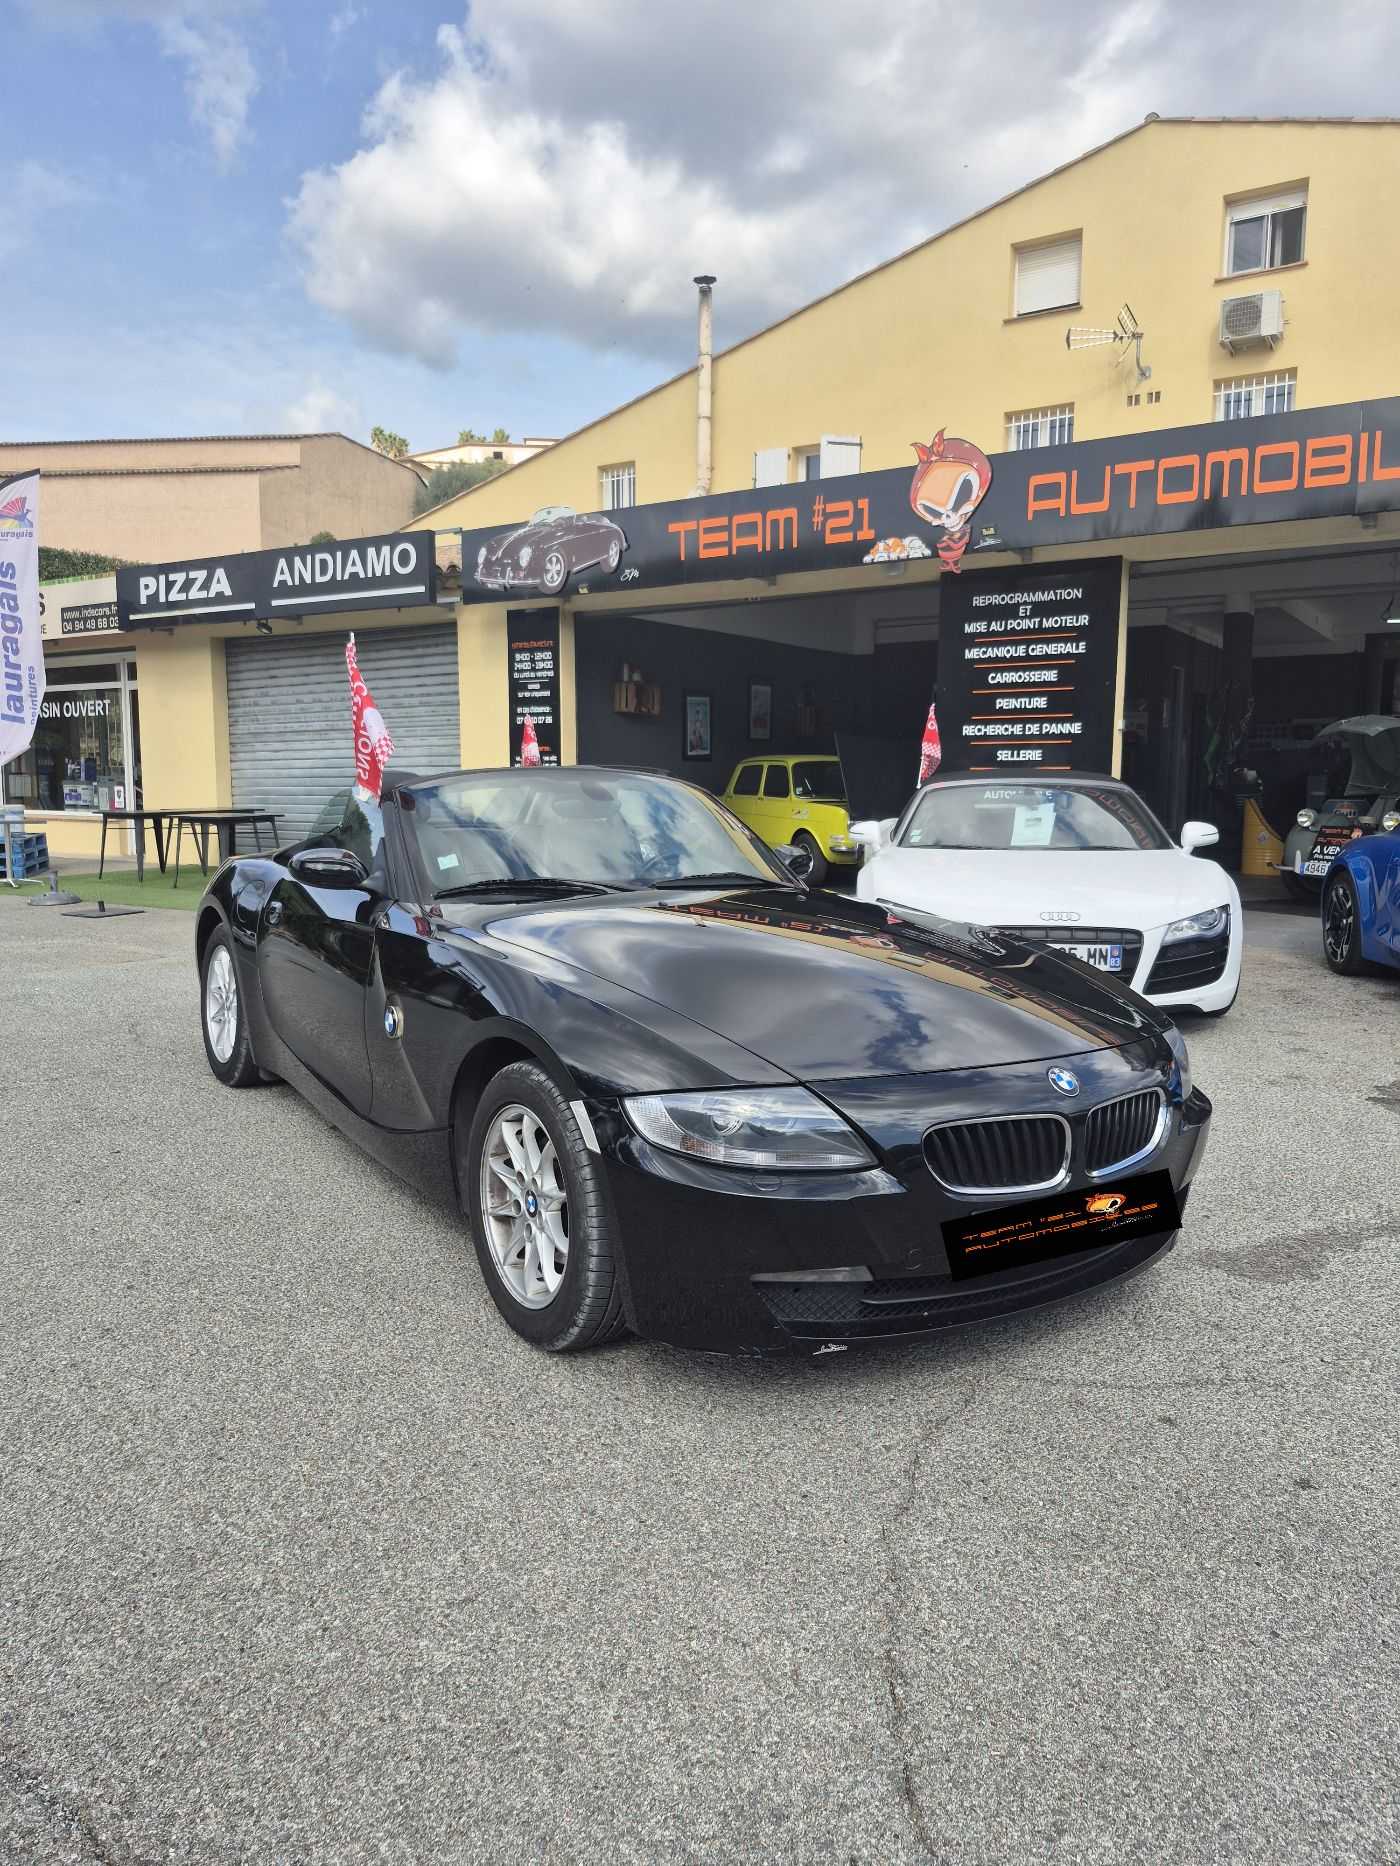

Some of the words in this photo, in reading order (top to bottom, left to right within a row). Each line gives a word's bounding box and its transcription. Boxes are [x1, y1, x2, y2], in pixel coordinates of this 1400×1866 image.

[1027, 430, 1400, 520] AUTOMOBIL
[668, 507, 799, 561] TEAM
[812, 495, 875, 546] #21
[272, 542, 417, 588] ANDIAMO
[139, 567, 232, 605] PIZZA
[972, 588, 1082, 607] REPROGRAMMATION
[1019, 606, 1031, 617] ET
[63, 621, 73, 632] 04
[86, 619, 96, 630] 49
[964, 621, 987, 634] MISE
[990, 620, 1005, 632] AU
[1007, 617, 1041, 631] POINT
[1043, 615, 1089, 629] MOTEUR
[964, 645, 1026, 660] MECANIQUE
[1028, 642, 1086, 656] GENERALE
[988, 670, 1058, 684] CARROSSERIE
[63, 700, 111, 718] OUVERT
[996, 697, 1047, 710] PEINTURE
[962, 724, 1024, 737] RECHERCHE
[1025, 724, 1041, 735] DE
[1042, 722, 1082, 735] PANNE
[996, 749, 1043, 761] SELLERIE
[1313, 845, 1321, 854] A
[1111, 958, 1120, 966] 83
